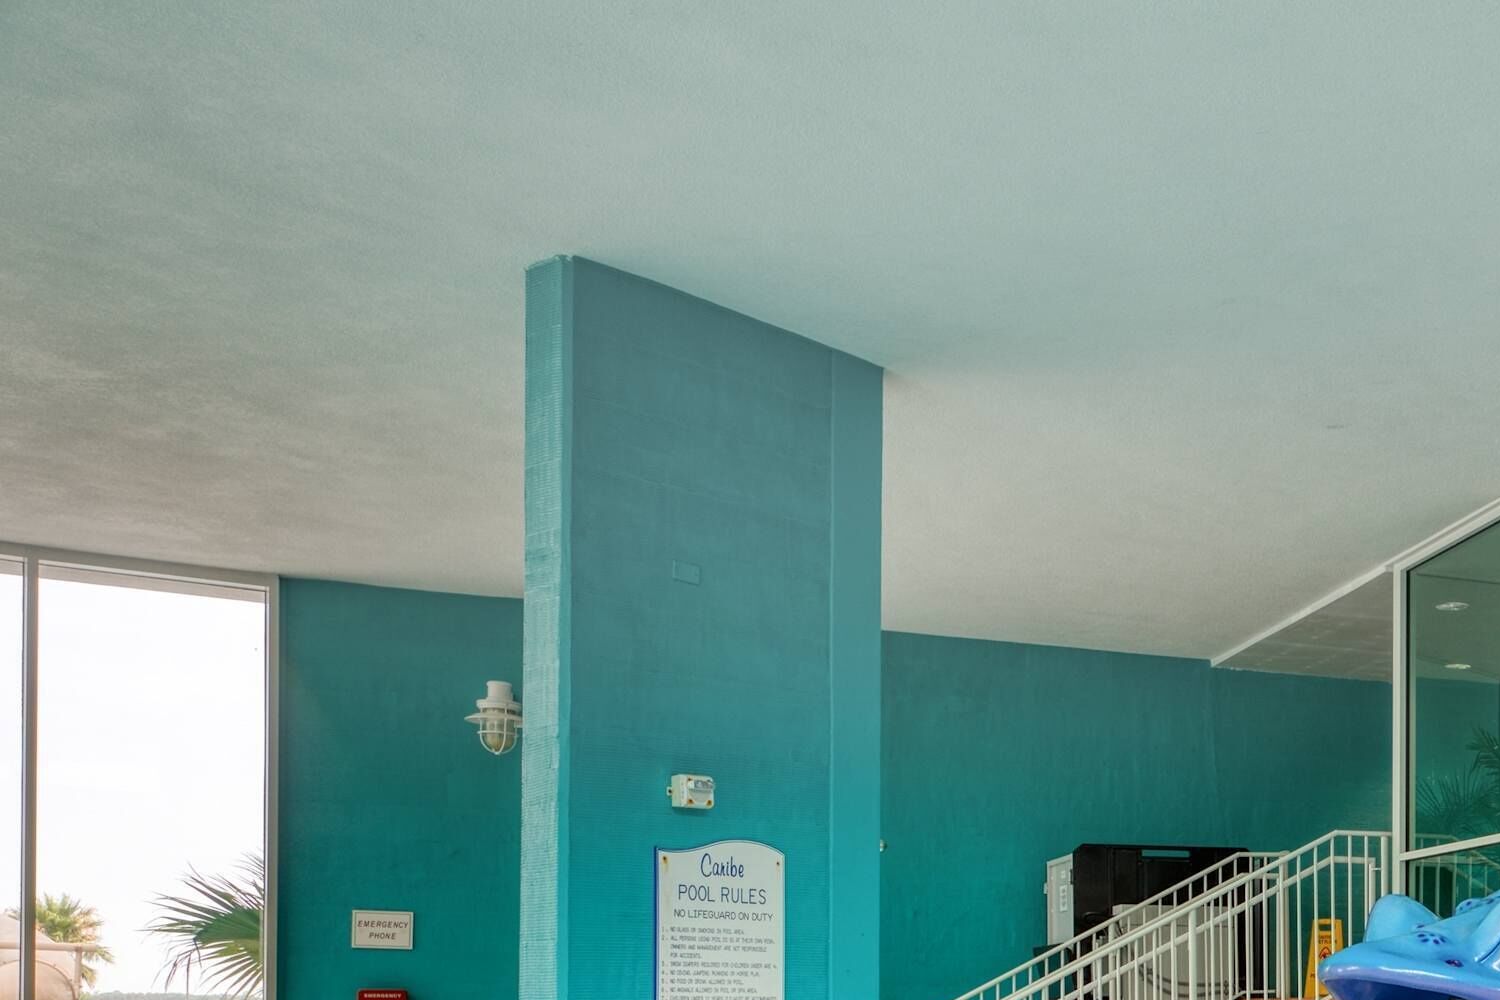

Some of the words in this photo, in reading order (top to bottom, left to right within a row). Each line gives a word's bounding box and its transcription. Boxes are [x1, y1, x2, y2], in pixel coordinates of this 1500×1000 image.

[701, 853, 744, 878] Caribe
[678, 884, 715, 902] POOL
[721, 887, 766, 904] RULES
[674, 909, 685, 917] NO
[688, 910, 736, 920] LIFEGUARD
[738, 912, 749, 920] ON
[752, 912, 773, 921] DUTY
[358, 920, 408, 928] EMERGENCY
